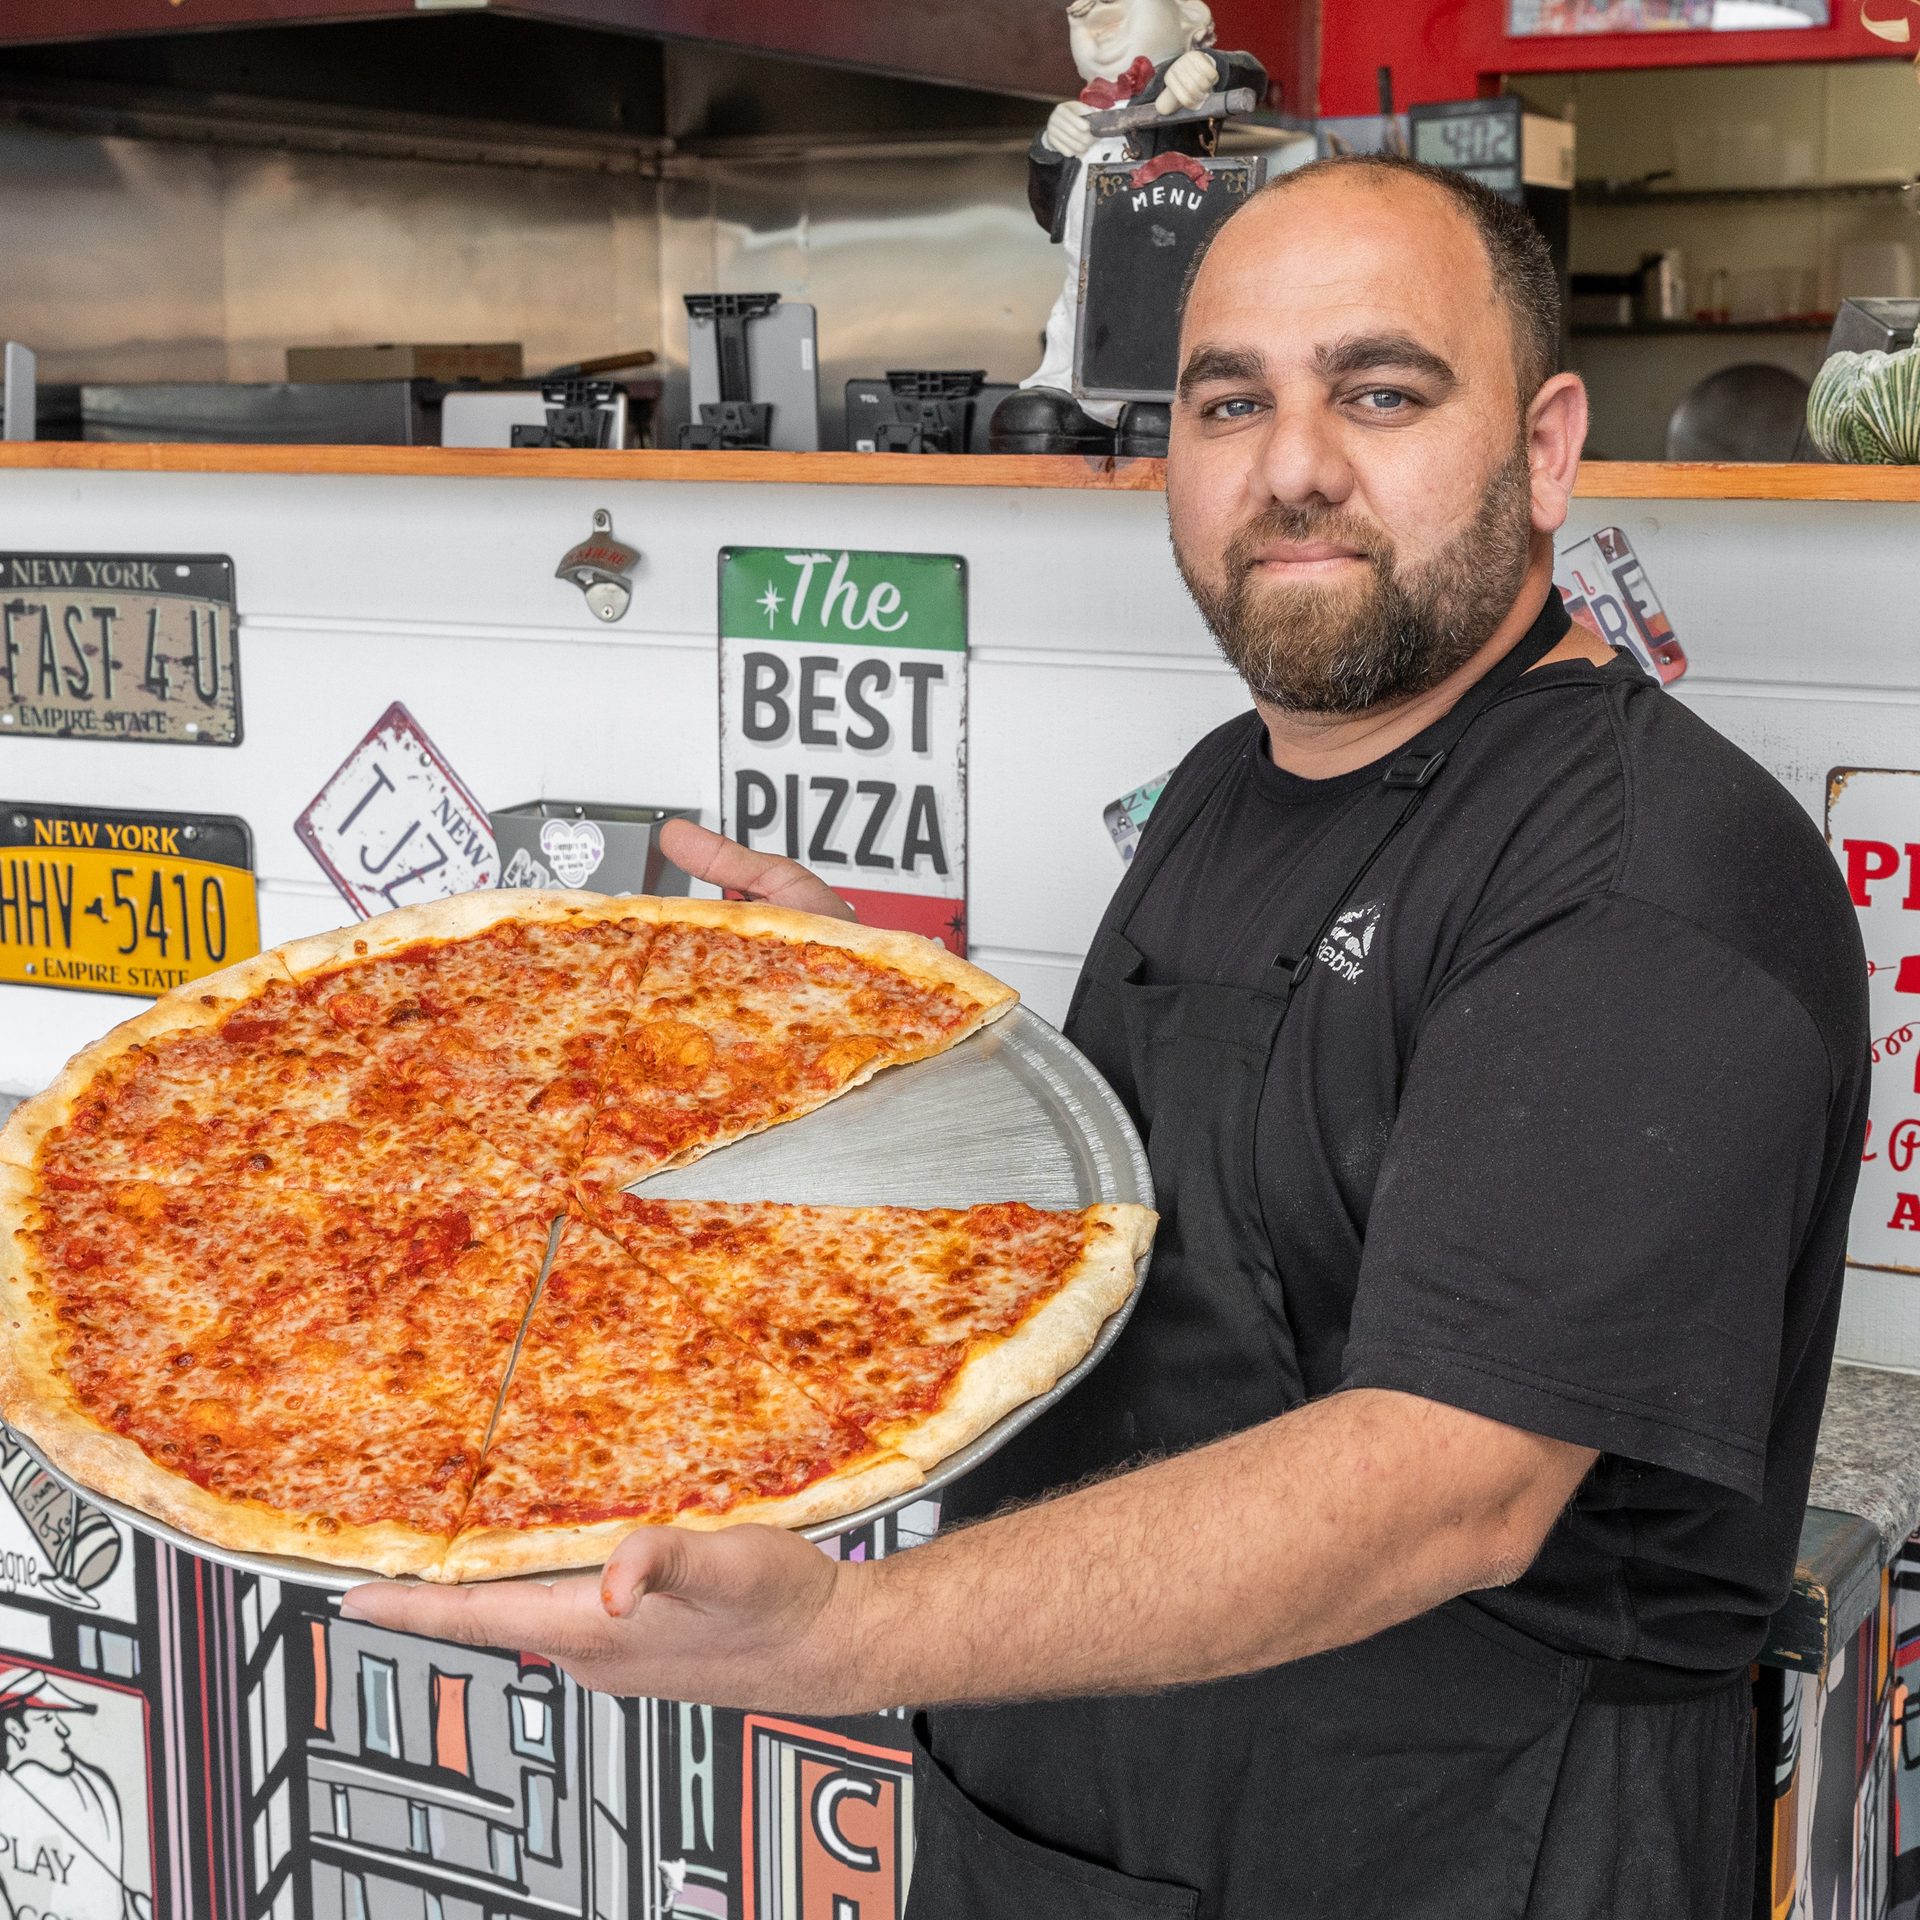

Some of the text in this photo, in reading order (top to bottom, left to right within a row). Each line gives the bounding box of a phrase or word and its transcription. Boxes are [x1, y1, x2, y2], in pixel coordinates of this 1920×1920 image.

[1131, 186, 1203, 212] MENU
[12, 559, 161, 590] NEW YORK
[784, 551, 909, 632] The
[3, 603, 220, 704] FAST 4 U
[20, 705, 168, 734] EMPIRE STATE
[742, 651, 944, 755] BEST
[33, 818, 181, 855] NEW YORK
[430, 796, 494, 869] NEW
[735, 769, 949, 876] PIZZA
[43, 957, 190, 989] EMPIRE STATE
